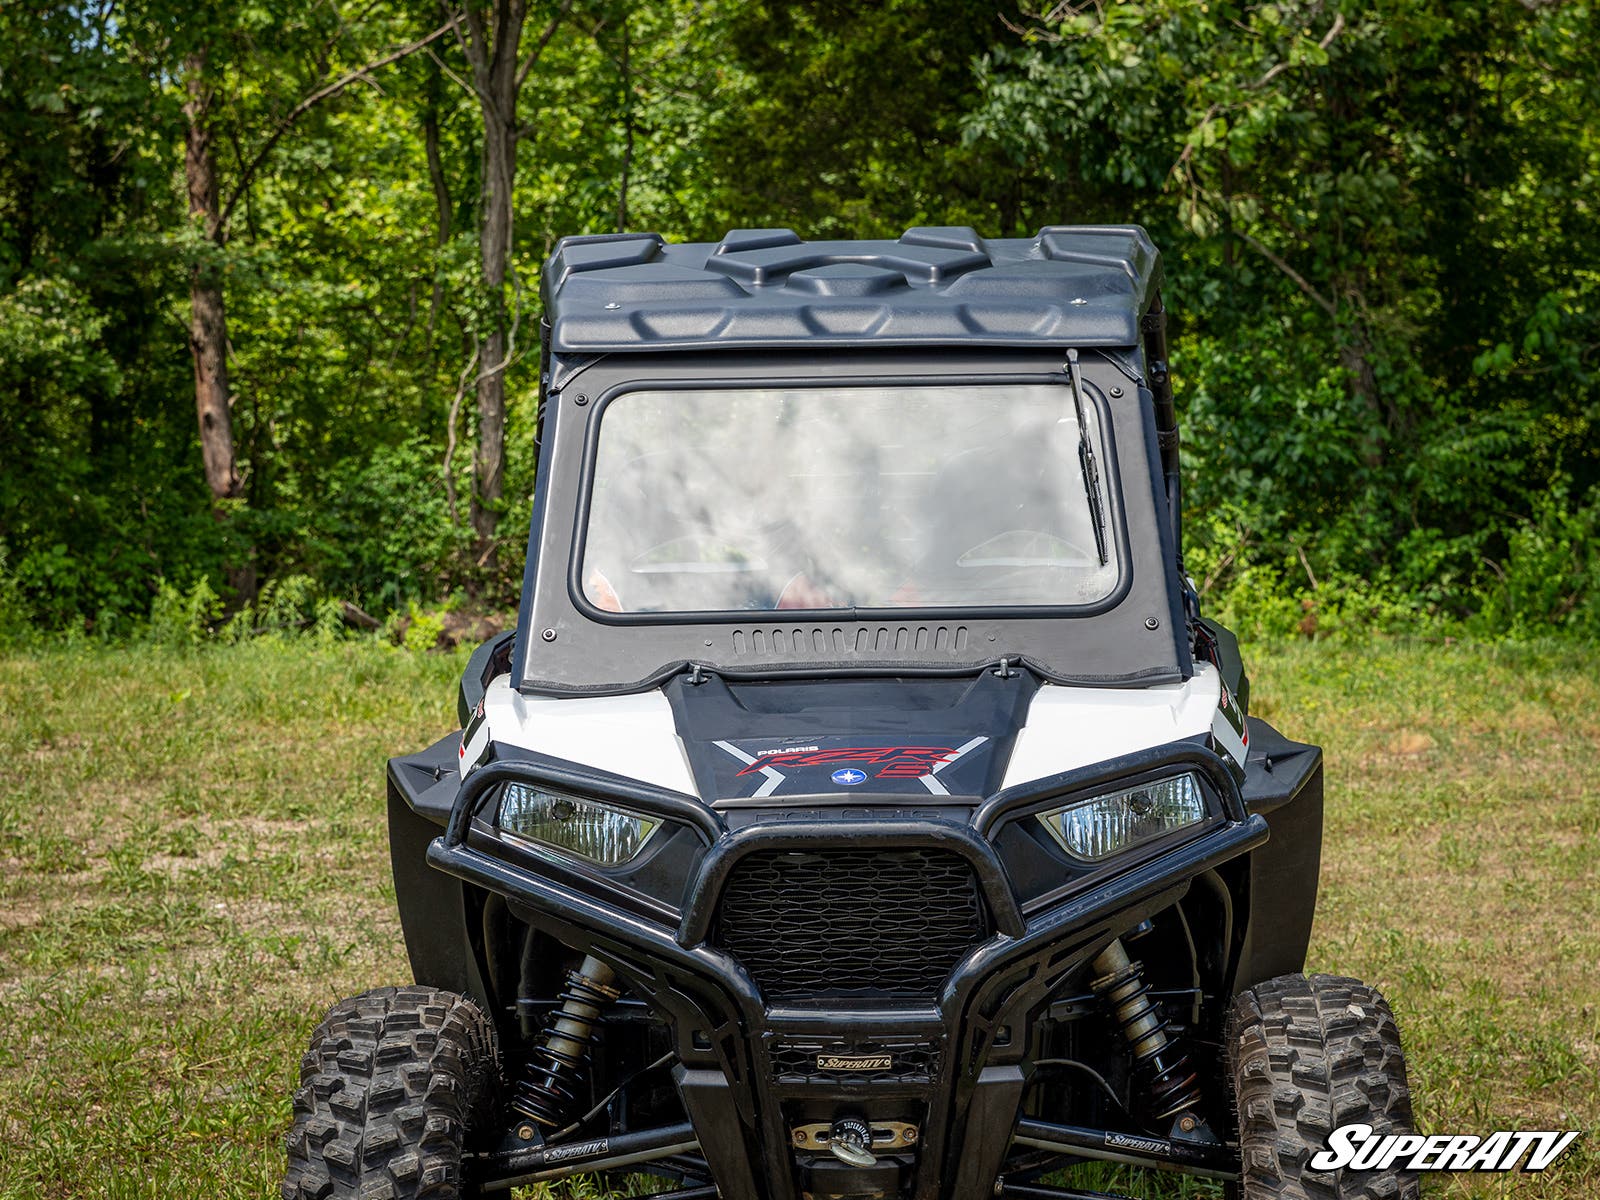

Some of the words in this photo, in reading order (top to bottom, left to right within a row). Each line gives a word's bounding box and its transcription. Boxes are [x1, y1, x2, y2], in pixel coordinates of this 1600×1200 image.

[757, 746, 819, 756] POLARIS
[824, 1058, 884, 1069] SUPERATV
[1111, 1134, 1164, 1152] SUPERATV
[551, 1142, 602, 1160] SUPERATV
